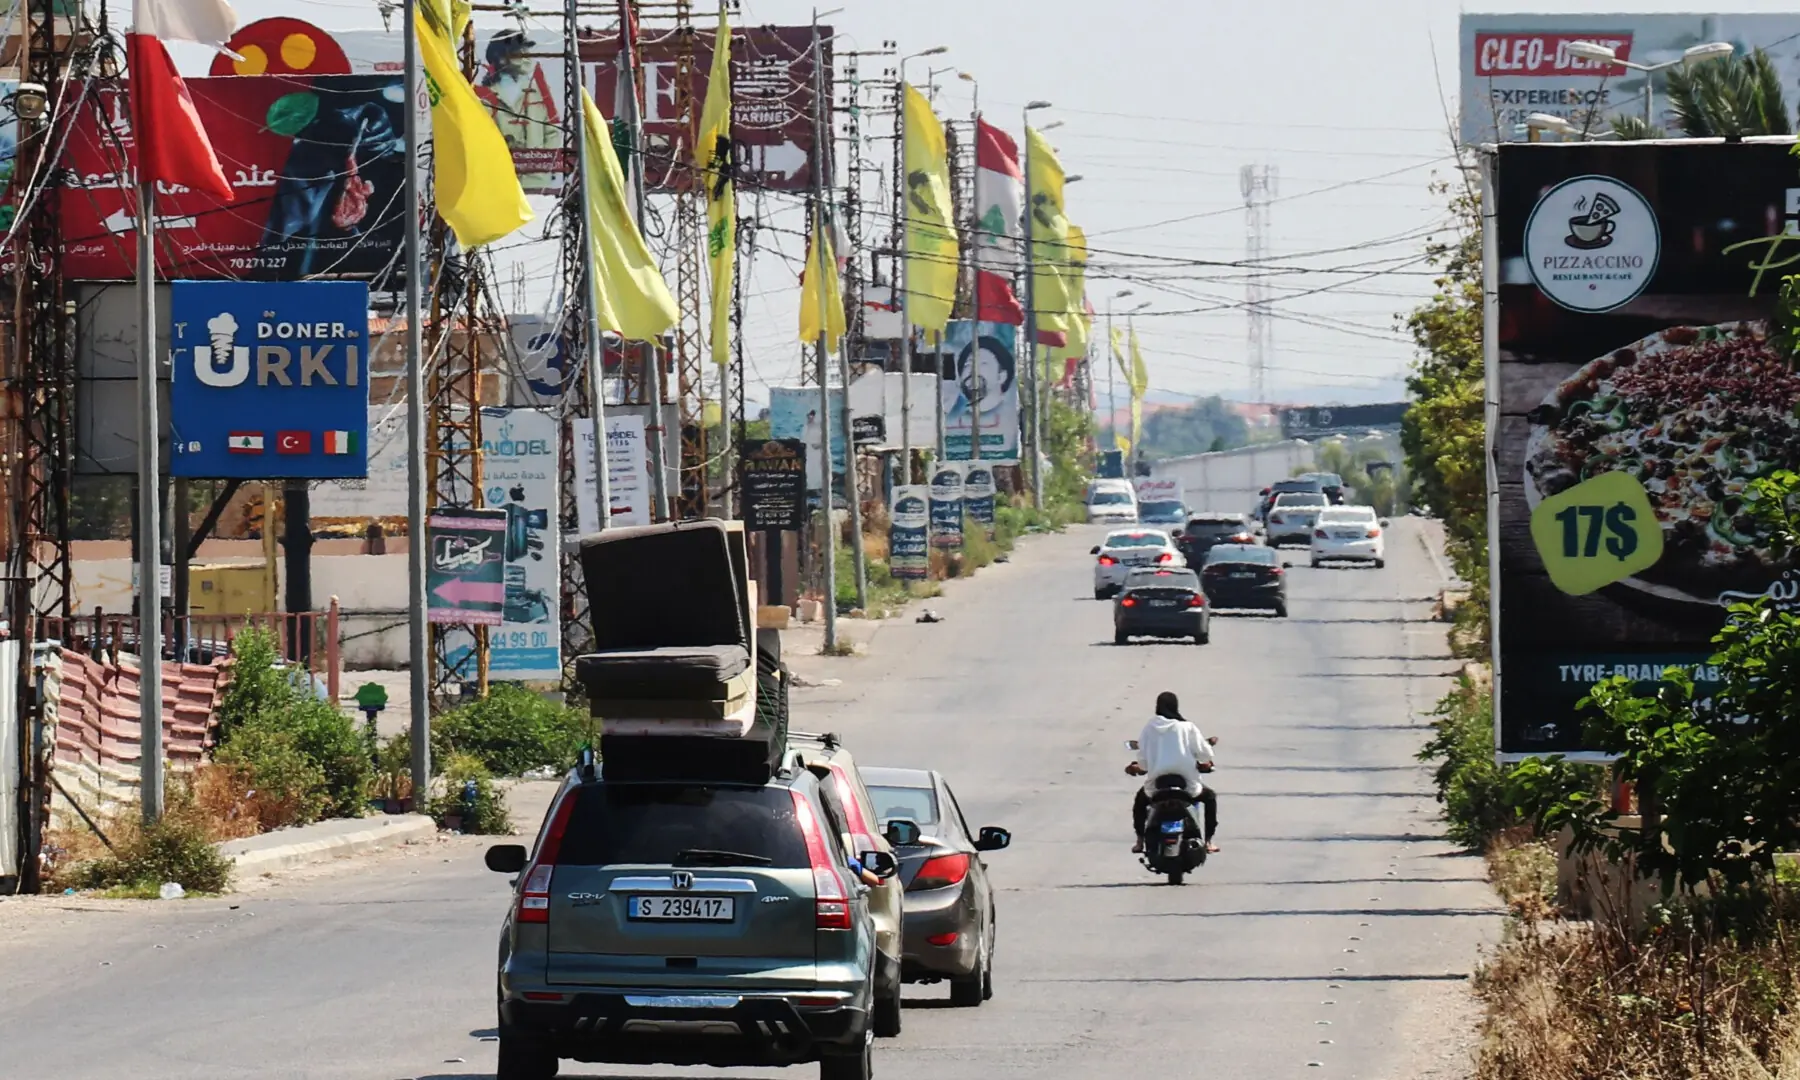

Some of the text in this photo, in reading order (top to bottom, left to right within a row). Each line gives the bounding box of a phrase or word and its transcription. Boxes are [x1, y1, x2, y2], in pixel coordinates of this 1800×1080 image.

[232, 163, 278, 188] عند
[267, 257, 287, 268] 227
[1543, 255, 1643, 269] PIZZACCINO
[1552, 273, 1604, 281] RESTAURANT
[1555, 501, 1638, 561] 17$
[1559, 664, 1687, 682] TYRE-BRAN
[641, 899, 722, 917] S 239417
